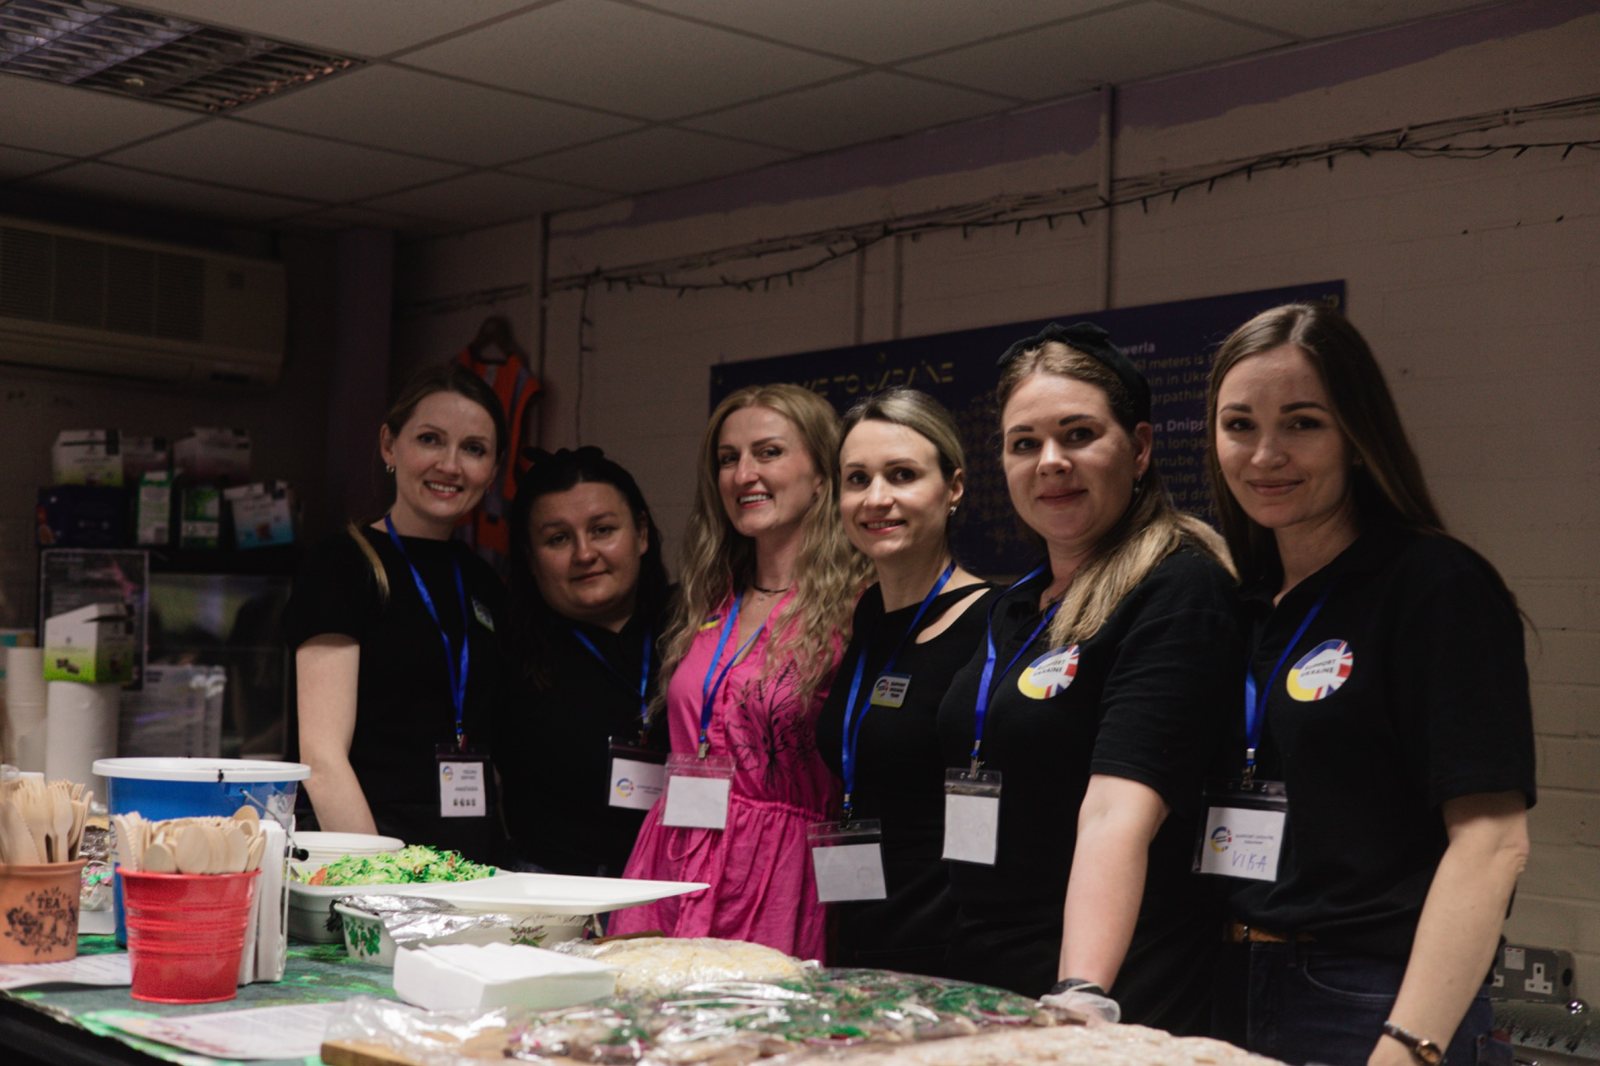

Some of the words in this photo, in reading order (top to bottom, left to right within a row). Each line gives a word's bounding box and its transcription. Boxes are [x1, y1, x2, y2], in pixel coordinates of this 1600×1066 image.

[1151, 356, 1193, 369] meters
[1195, 353, 1205, 365] is
[1167, 371, 1180, 384] in
[38, 897, 61, 909] TEA
